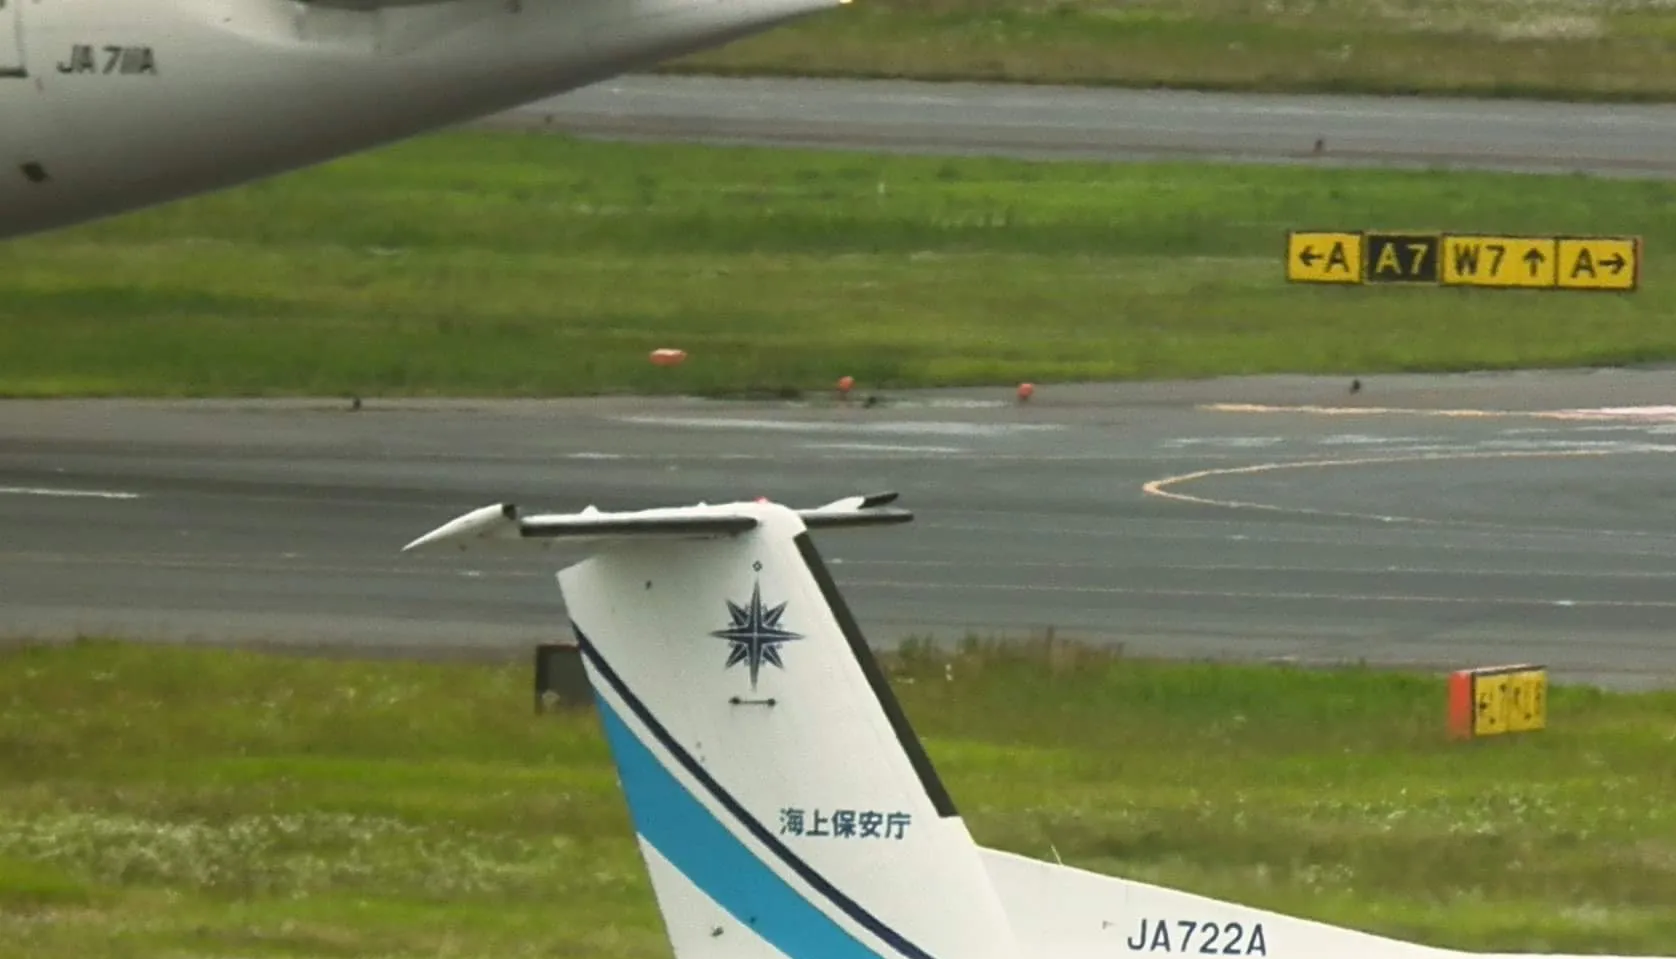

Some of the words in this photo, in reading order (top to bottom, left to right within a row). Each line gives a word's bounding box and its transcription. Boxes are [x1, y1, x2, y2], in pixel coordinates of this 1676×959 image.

[1324, 241, 1349, 273] A
[1375, 242, 1429, 274] A7
[1453, 244, 1506, 277] W7
[1570, 247, 1596, 279] A
[779, 807, 911, 840] 海上保安庁
[1127, 918, 1267, 957] JA722A
